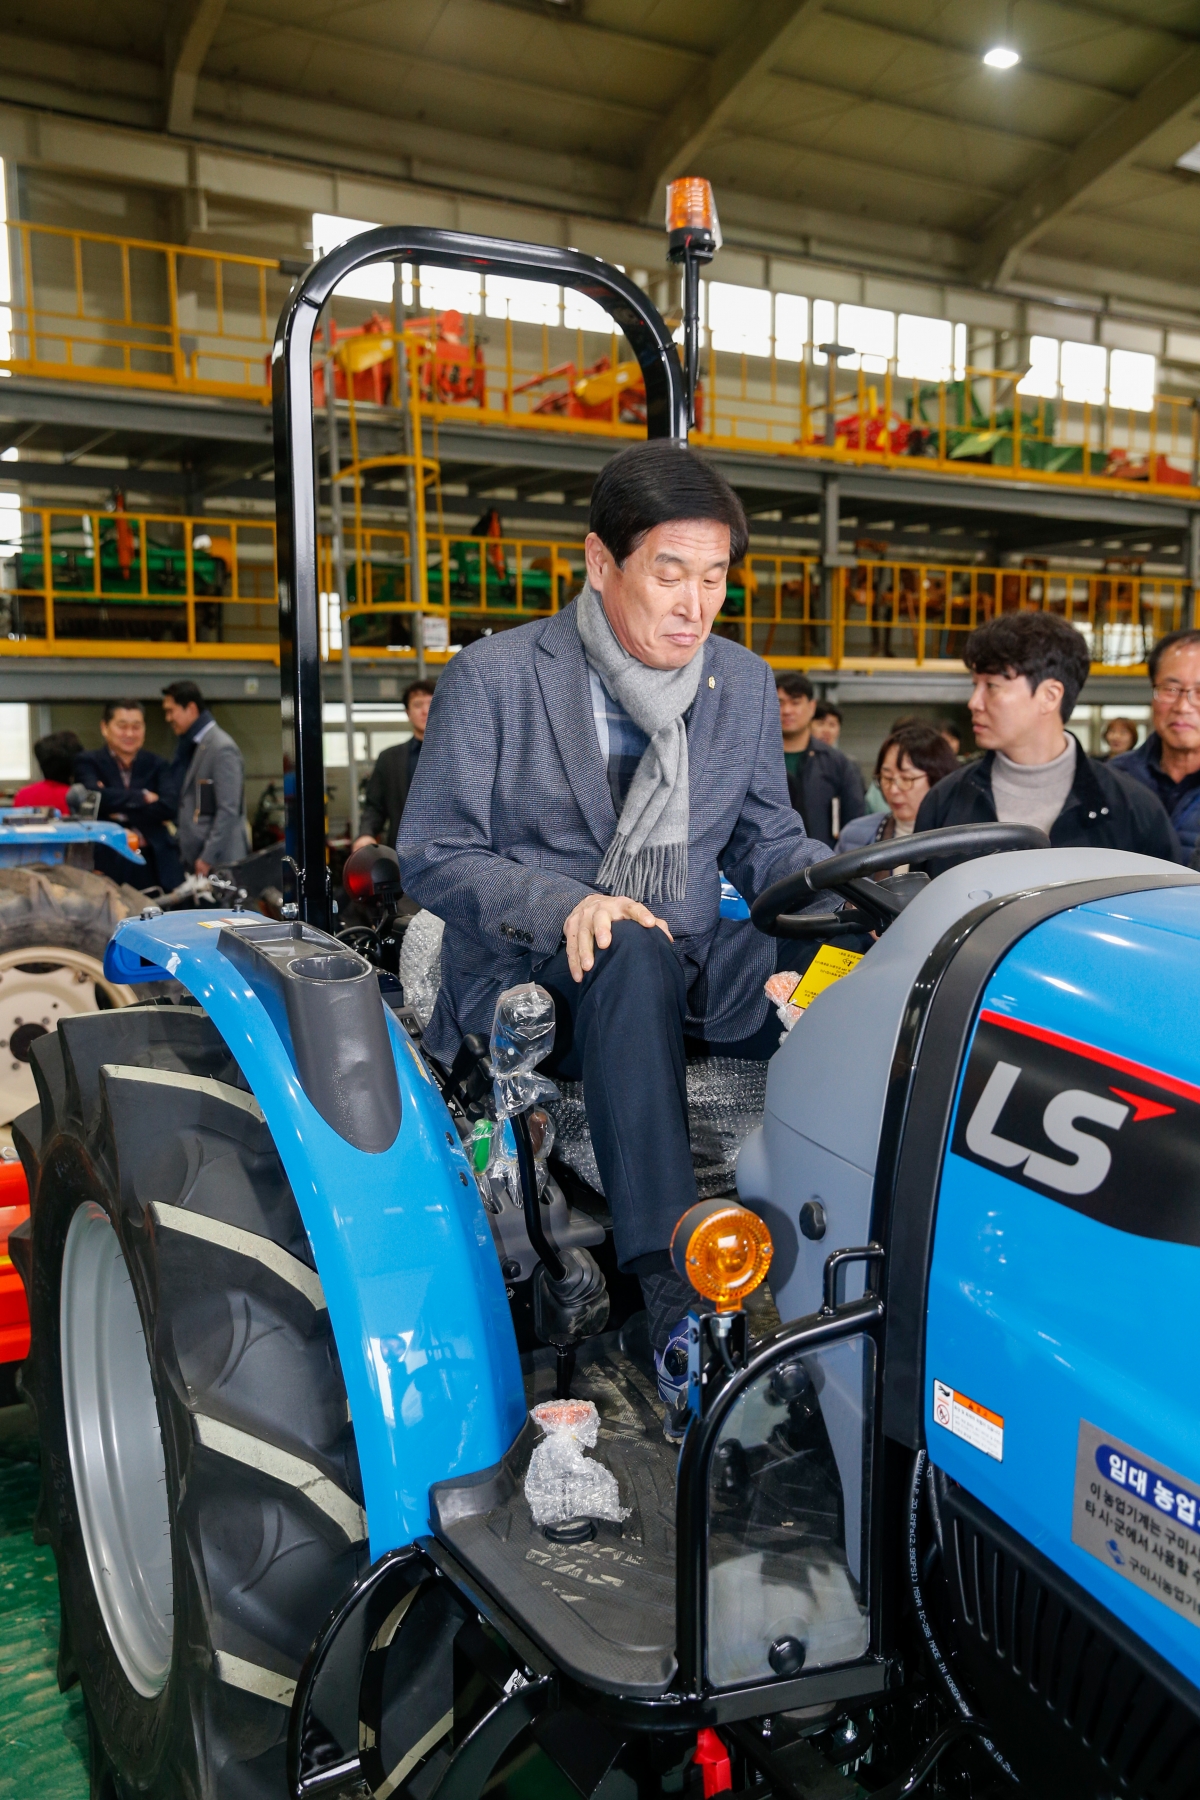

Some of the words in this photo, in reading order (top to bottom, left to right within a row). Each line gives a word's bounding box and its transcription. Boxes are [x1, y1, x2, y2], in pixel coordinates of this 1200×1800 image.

[966, 1060, 1129, 1195] LS
[1090, 1482, 1101, 1500] 이
[1103, 1489, 1162, 1538] 농업기계는
[1109, 1453, 1148, 1498] 임대
[1153, 1479, 1200, 1527] 농업
[1085, 1500, 1096, 1517] 타
[1152, 1542, 1189, 1577] 사용할
[1129, 1556, 1200, 1616] 구미시농업기
[913, 1586, 922, 1607] MSHA
[928, 1639, 941, 1660] MADE
[938, 1662, 948, 1673] IN
[944, 1674, 961, 1699] KOREA
